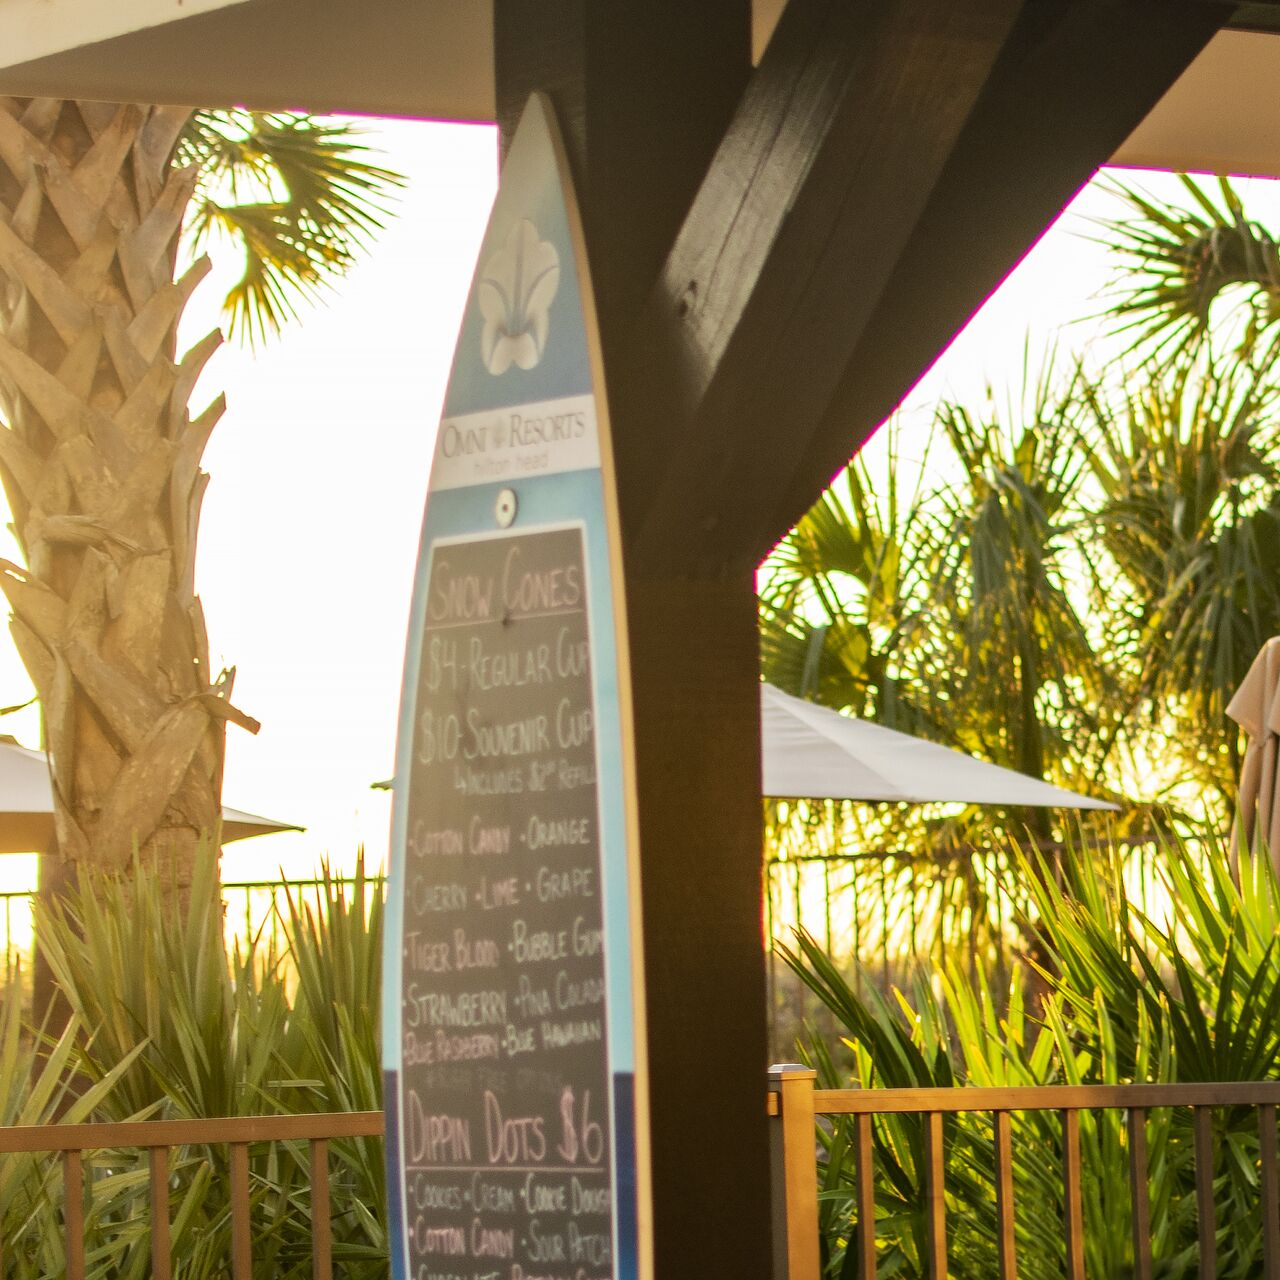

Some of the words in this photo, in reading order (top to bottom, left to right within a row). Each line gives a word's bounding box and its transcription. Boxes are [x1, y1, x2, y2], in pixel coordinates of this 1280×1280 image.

[430, 561, 495, 621] SNOW
[502, 546, 581, 611] CONES
[527, 815, 590, 851] ORANGE
[536, 866, 594, 902] GRAPE
[513, 919, 568, 963] BUBBLE
[407, 982, 508, 1027] STRAWBERRY
[484, 1089, 546, 1163] DOTS
[557, 1084, 604, 1163] $6
